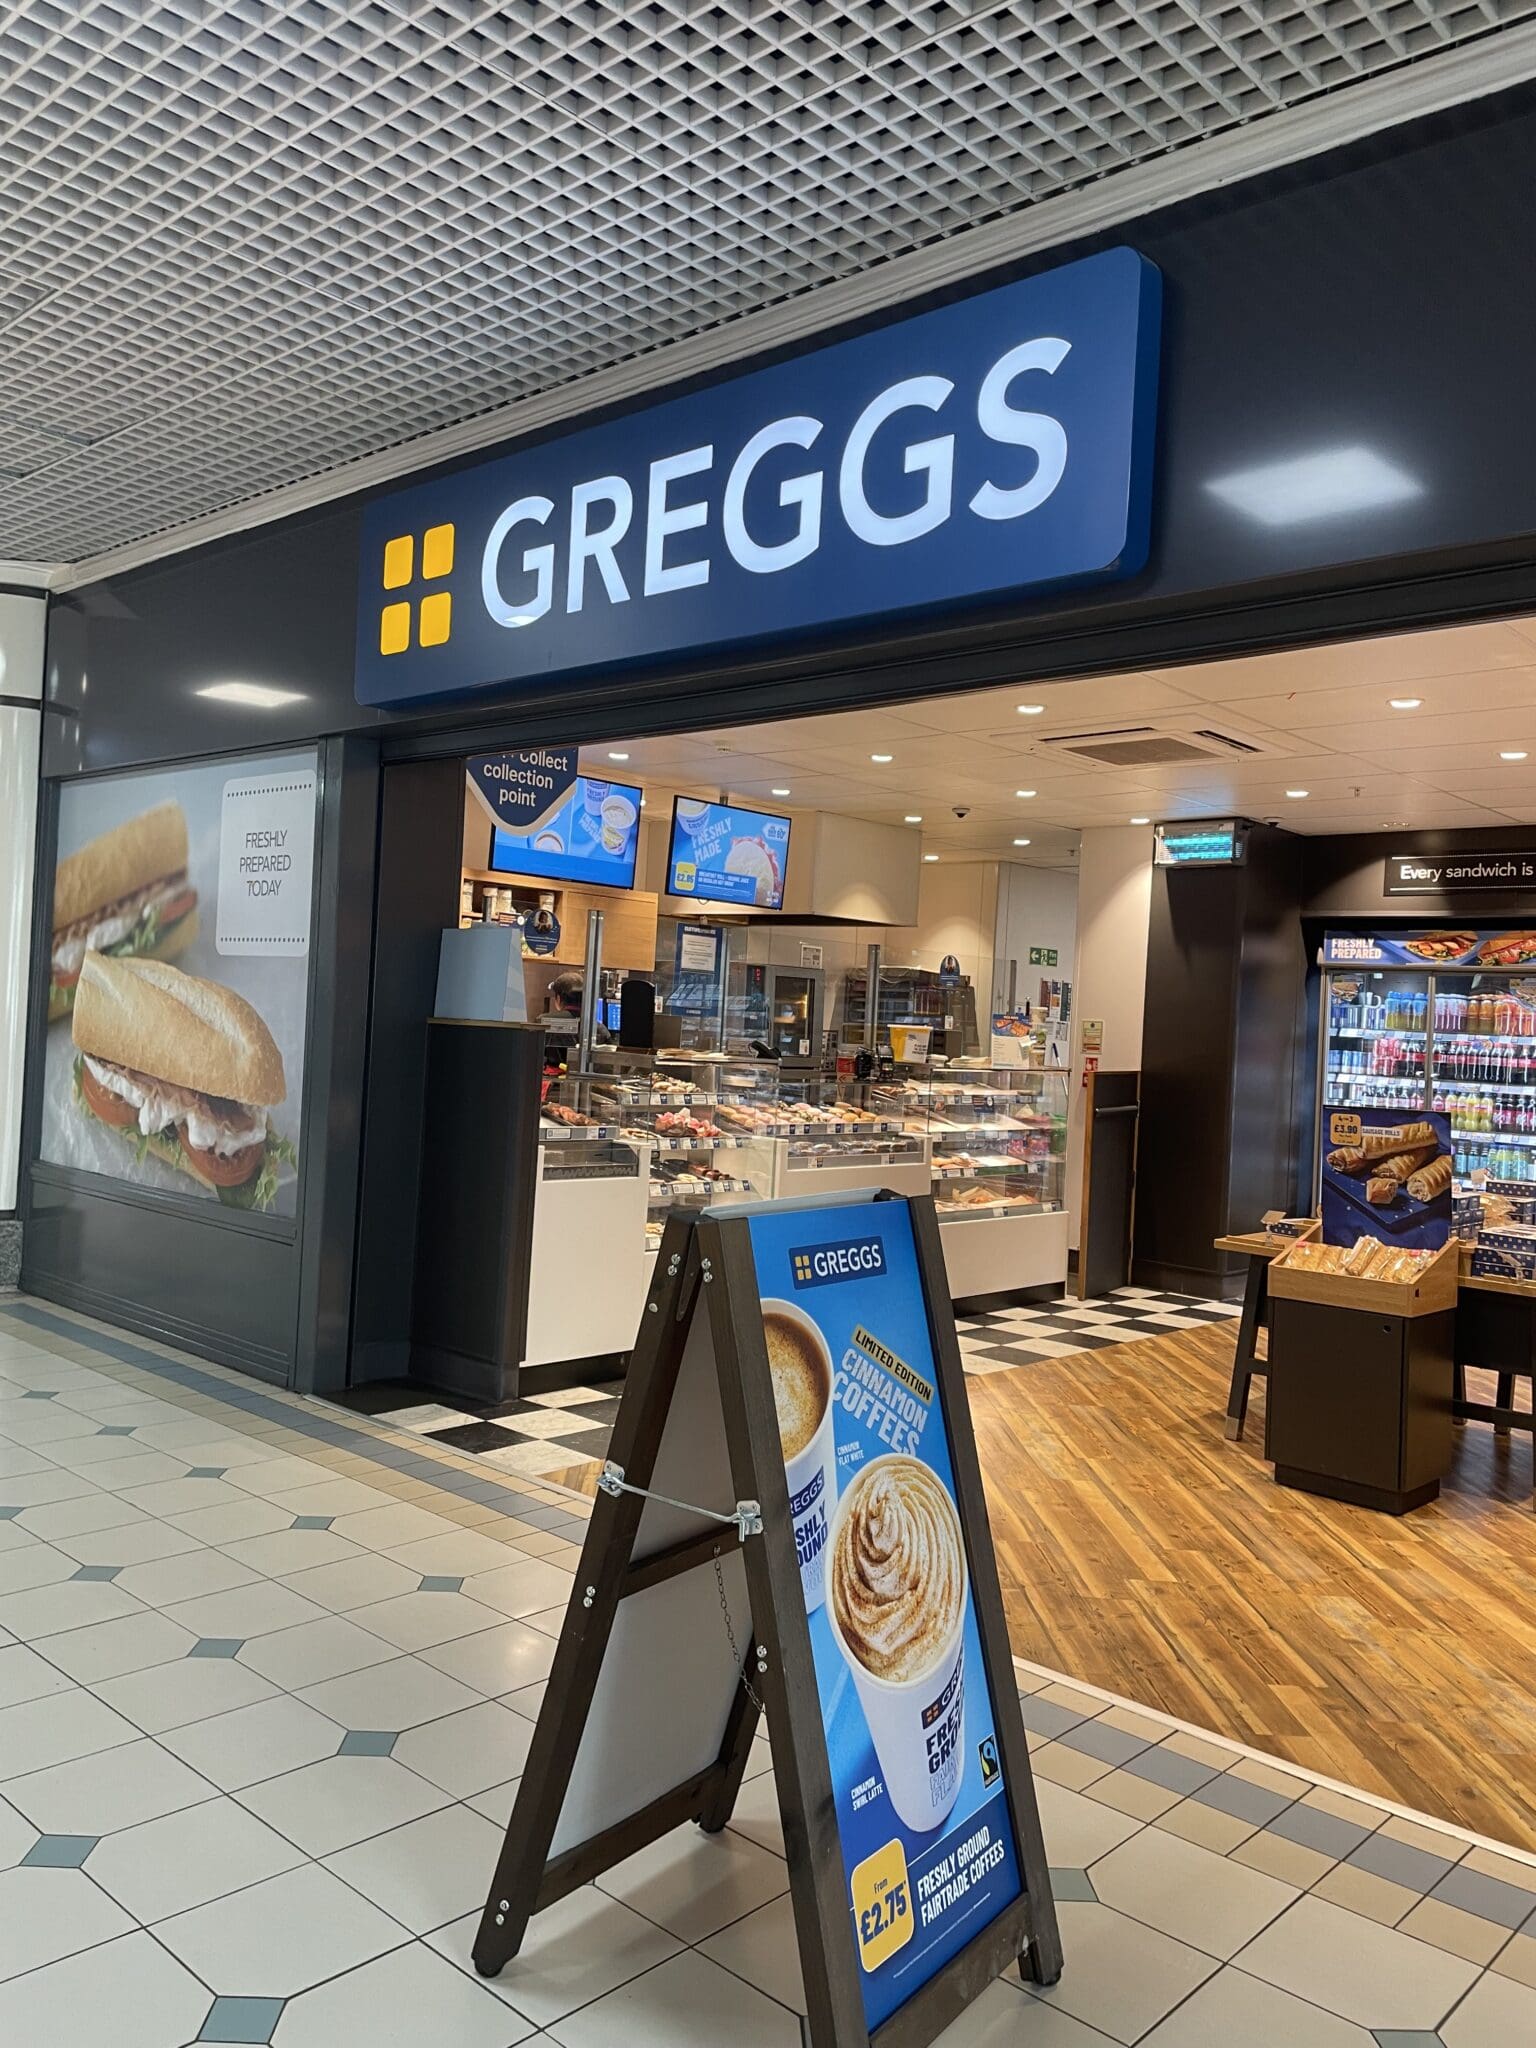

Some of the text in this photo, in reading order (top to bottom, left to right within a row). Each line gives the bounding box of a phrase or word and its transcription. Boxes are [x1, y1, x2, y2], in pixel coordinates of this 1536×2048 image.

[481, 337, 1072, 628] GREGGS
[483, 763, 553, 789] collection
[499, 788, 536, 807] point
[245, 830, 287, 849] FRESHLY
[691, 816, 732, 849] FRESHLY
[694, 839, 722, 865] MADE
[239, 855, 292, 873] PREPARED
[1400, 862, 1534, 882] Every sandwich is
[246, 880, 282, 897] TODAY
[1331, 938, 1375, 949] FRESHLY
[1331, 948, 1382, 959] PREPARED
[814, 1244, 882, 1277] GREGGS
[855, 1330, 932, 1401] LIMITED EDITION
[842, 1348, 928, 1433] CINNAMON
[833, 1371, 920, 1457] COFFEES
[838, 1450, 864, 1466] FLAT WHITE
[867, 1783, 883, 1801] LATTE
[917, 1825, 990, 1901] FRESHLY GROUND
[874, 1878, 888, 1894] From
[921, 1839, 1005, 1927] FAIRTRADE COFFEES
